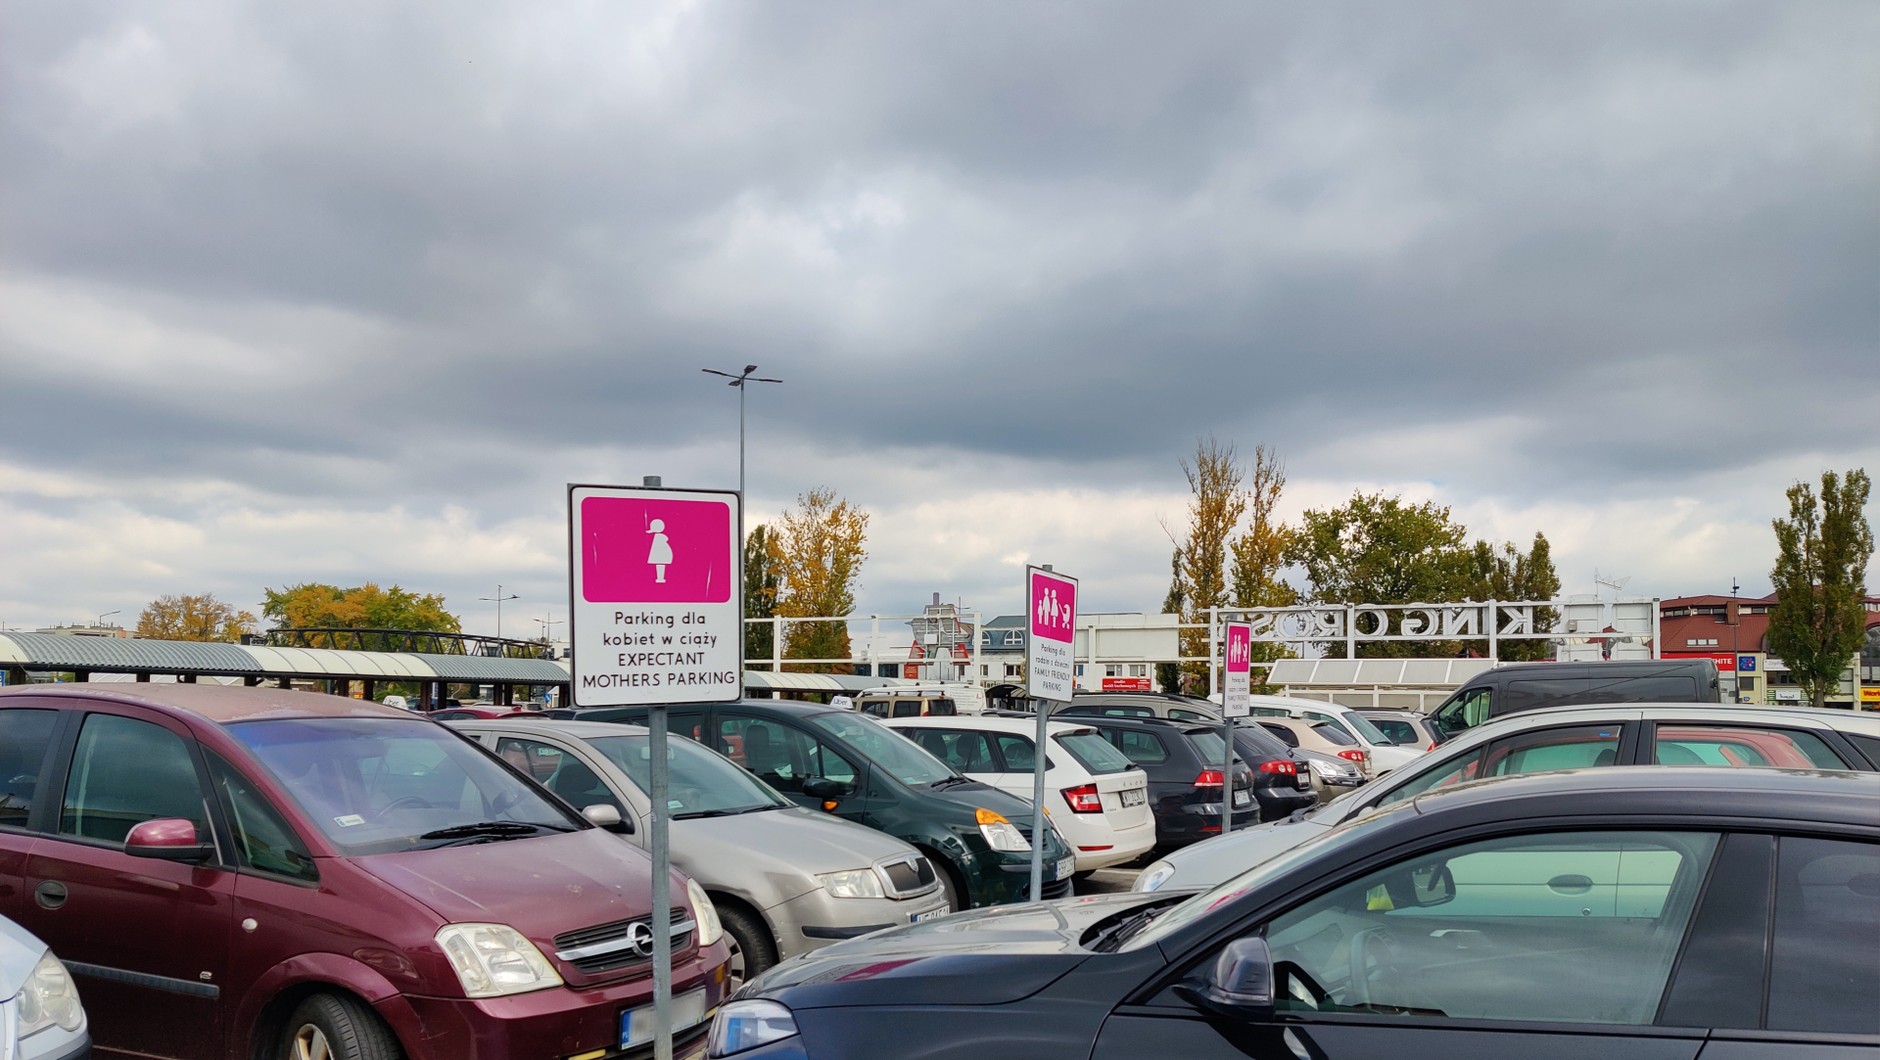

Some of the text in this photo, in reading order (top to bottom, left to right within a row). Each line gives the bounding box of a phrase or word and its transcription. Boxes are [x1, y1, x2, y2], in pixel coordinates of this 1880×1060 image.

[614, 611, 706, 628] Parking dla
[603, 632, 718, 649] kobiet w ciąży
[1041, 643, 1058, 656] Parking
[618, 652, 705, 667] EXPECTANT
[583, 671, 735, 688] MOTHERS PARKING
[1034, 666, 1070, 681] FAMILY FRIENDLY
[1043, 681, 1062, 692] PARKING
